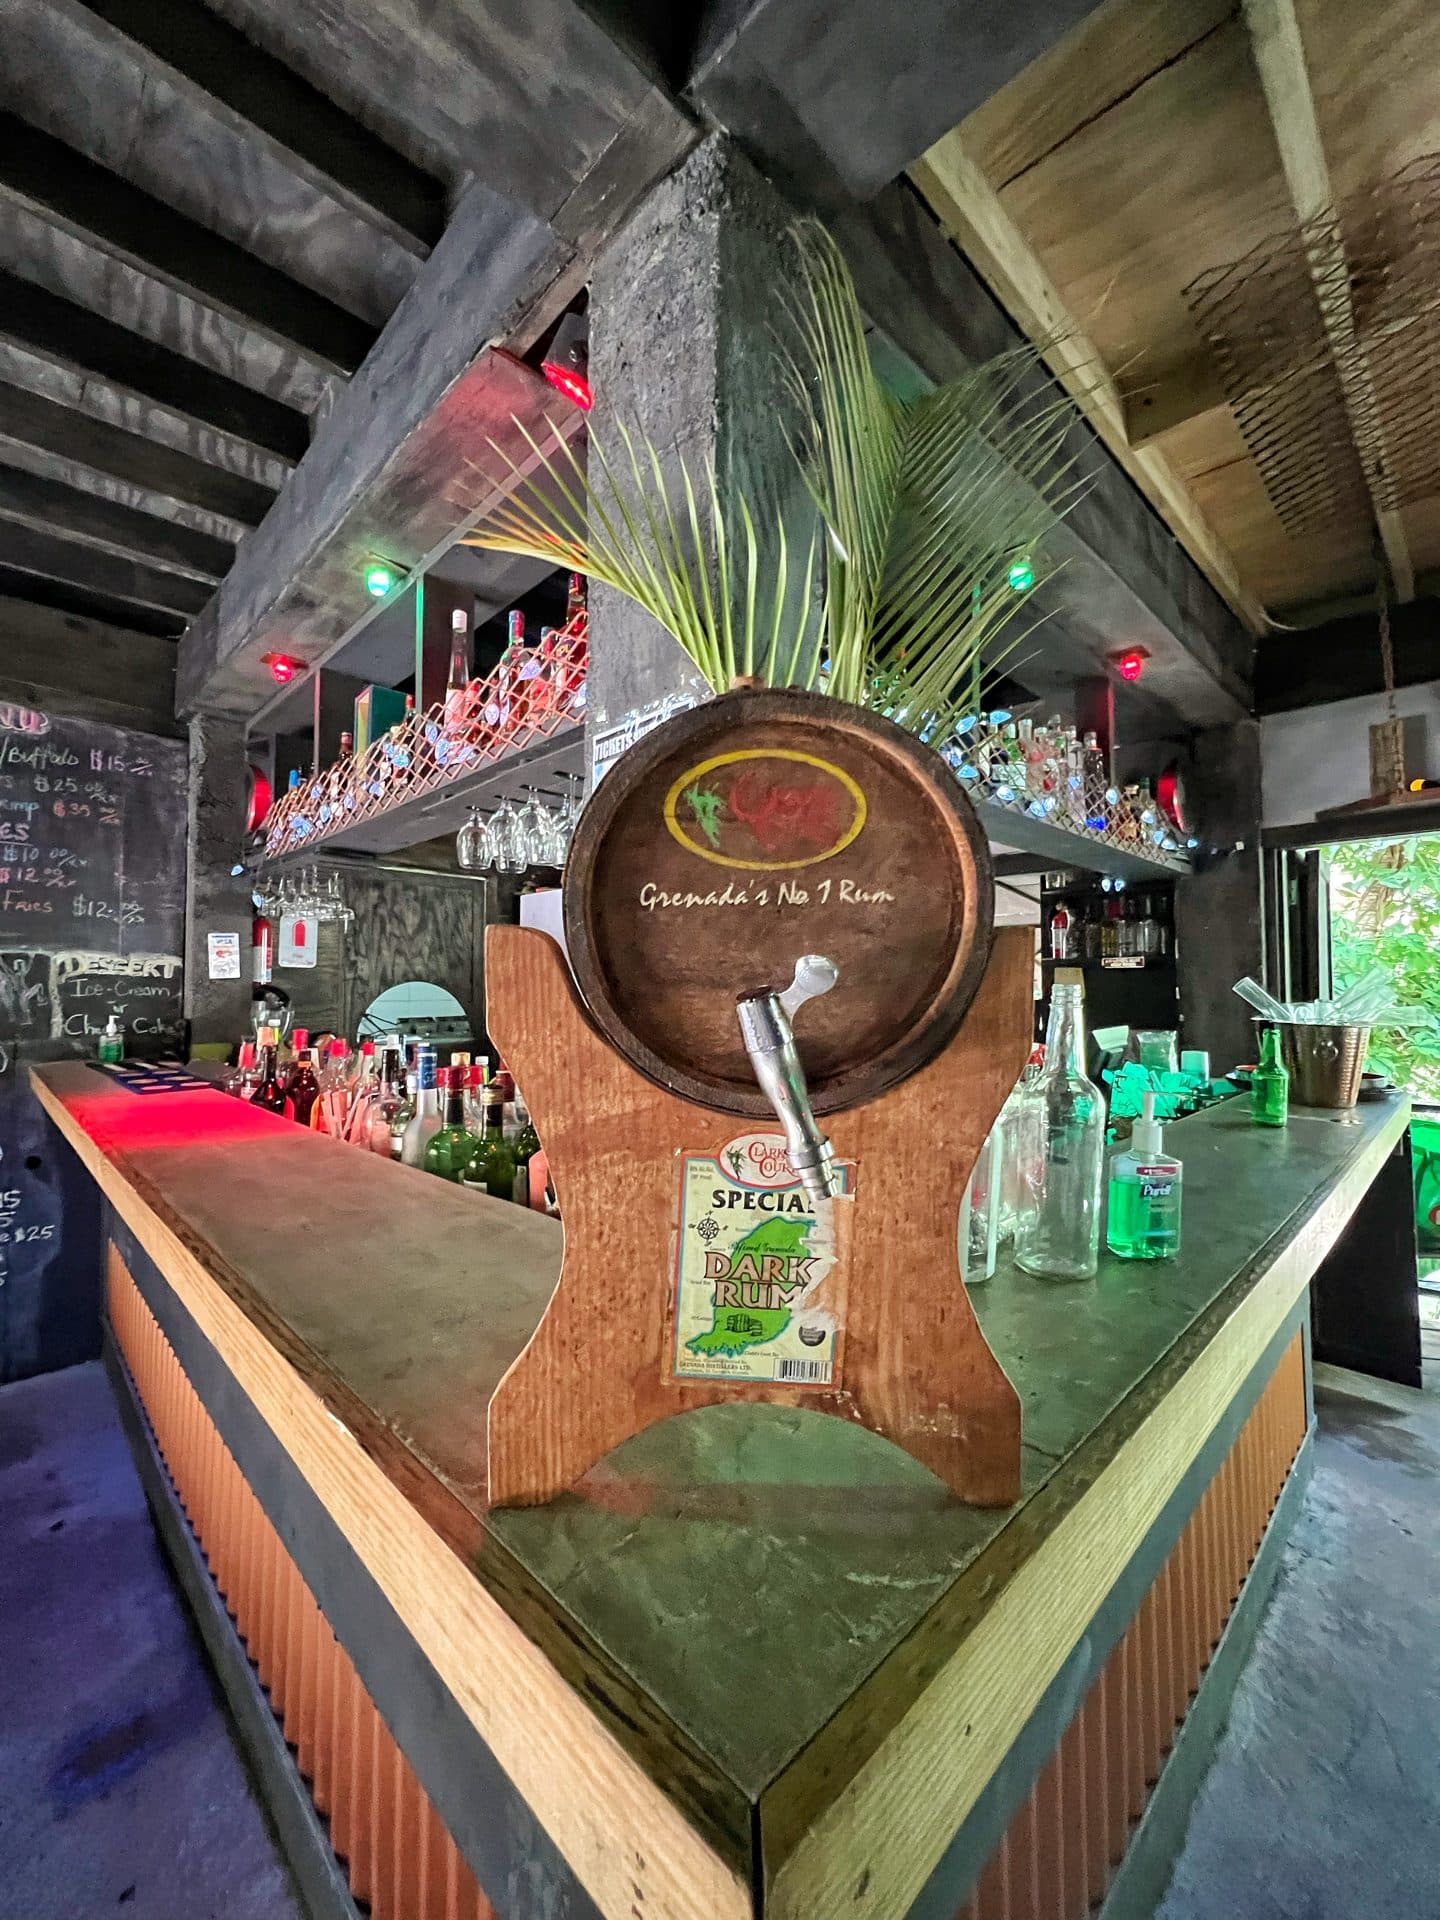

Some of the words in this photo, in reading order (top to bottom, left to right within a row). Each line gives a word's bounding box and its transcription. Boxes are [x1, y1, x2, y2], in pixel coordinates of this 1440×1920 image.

[639, 879, 769, 911] Grenada's
[816, 879, 832, 898] 1
[839, 879, 897, 904] Rum
[57, 951, 183, 983] DESSERT
[70, 977, 171, 998] Ice-Cream
[748, 1141, 790, 1163] CLARK
[759, 1157, 802, 1179] COUR
[704, 1251, 822, 1285] DARK
[714, 1279, 807, 1311] RUM
